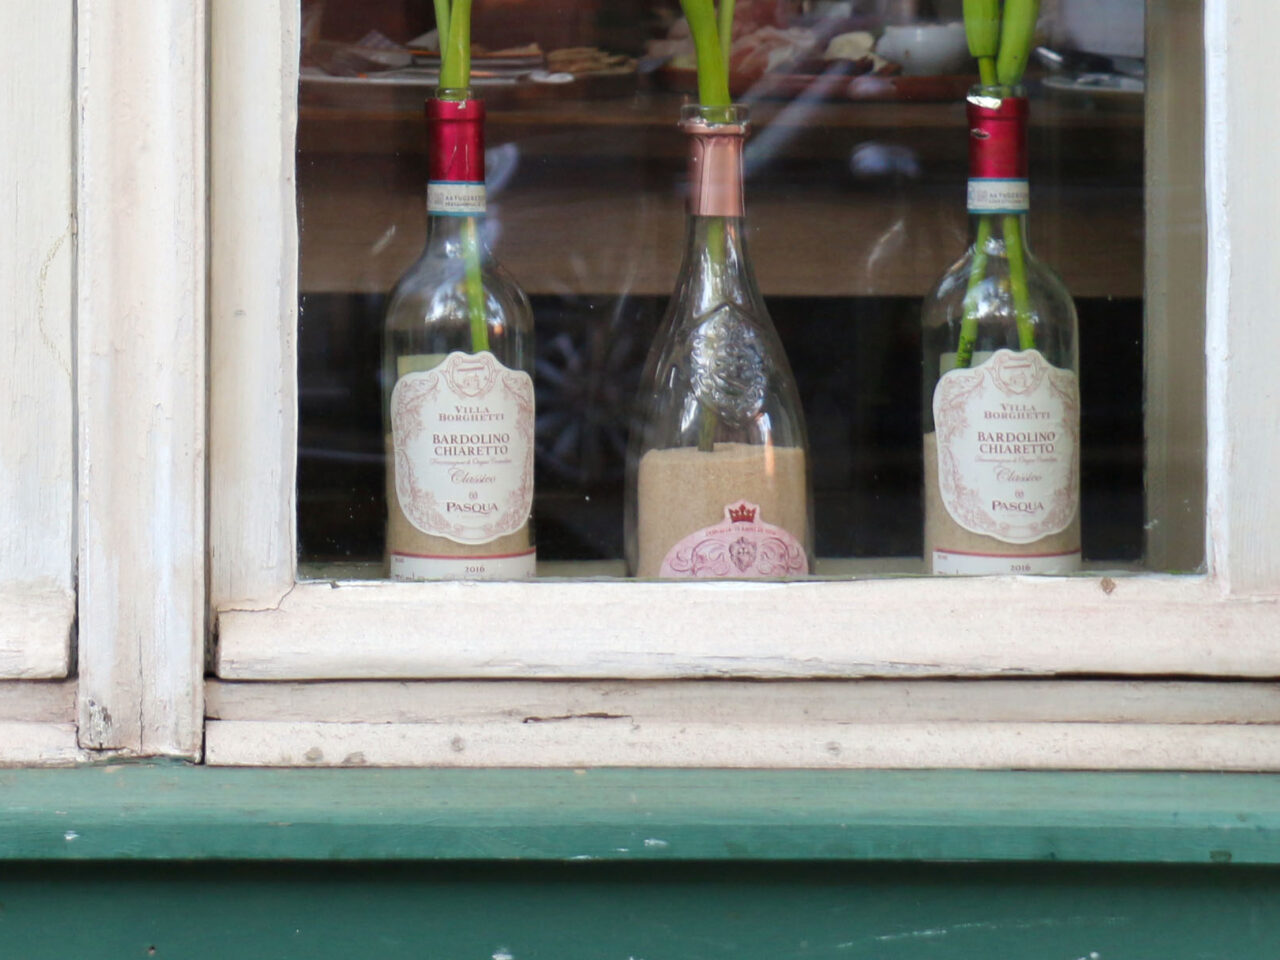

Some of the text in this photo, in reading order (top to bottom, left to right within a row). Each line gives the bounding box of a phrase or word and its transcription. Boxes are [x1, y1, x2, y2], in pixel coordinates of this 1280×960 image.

[455, 405, 490, 414] VILLA
[1001, 403, 1036, 412] VILLA
[438, 413, 505, 422] BORGHETTI
[983, 411, 1051, 420] BORGHETTI
[432, 433, 510, 445] BARDOLINO
[977, 431, 1056, 443] BARDOLINO
[434, 445, 508, 456] CHIARETTO
[979, 443, 1055, 454] CHIARETTO
[448, 466, 496, 484] Classico
[992, 464, 1043, 482] Classico
[446, 501, 499, 515] PASQUA
[991, 500, 1044, 514] PASQUA
[1010, 564, 1031, 572] 2016
